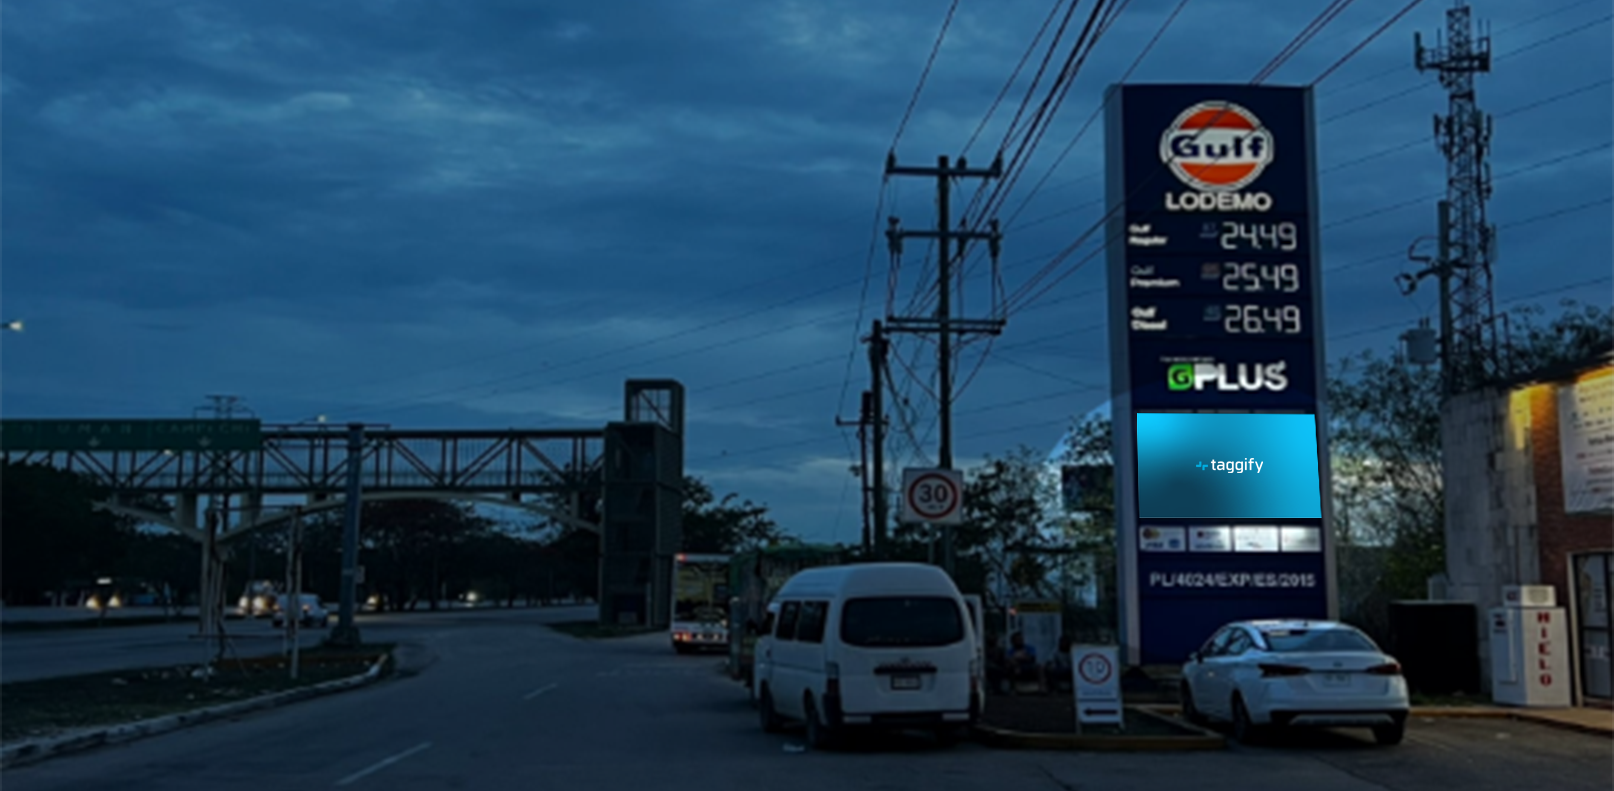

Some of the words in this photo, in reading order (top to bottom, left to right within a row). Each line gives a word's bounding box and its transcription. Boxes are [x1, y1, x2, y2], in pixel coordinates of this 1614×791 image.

[1171, 135, 1264, 158] Gulf
[1165, 192, 1273, 211] LODEMO
[1128, 236, 1168, 246] Regular
[1221, 222, 1297, 251] 24.49
[1130, 265, 1154, 275] Gulf
[1222, 263, 1299, 292] 25.49
[1130, 277, 1180, 288] Premium
[1224, 305, 1301, 333] 26.49
[1211, 458, 1263, 473] taggify
[919, 483, 948, 503] 30
[1537, 611, 1552, 687] HIELO
